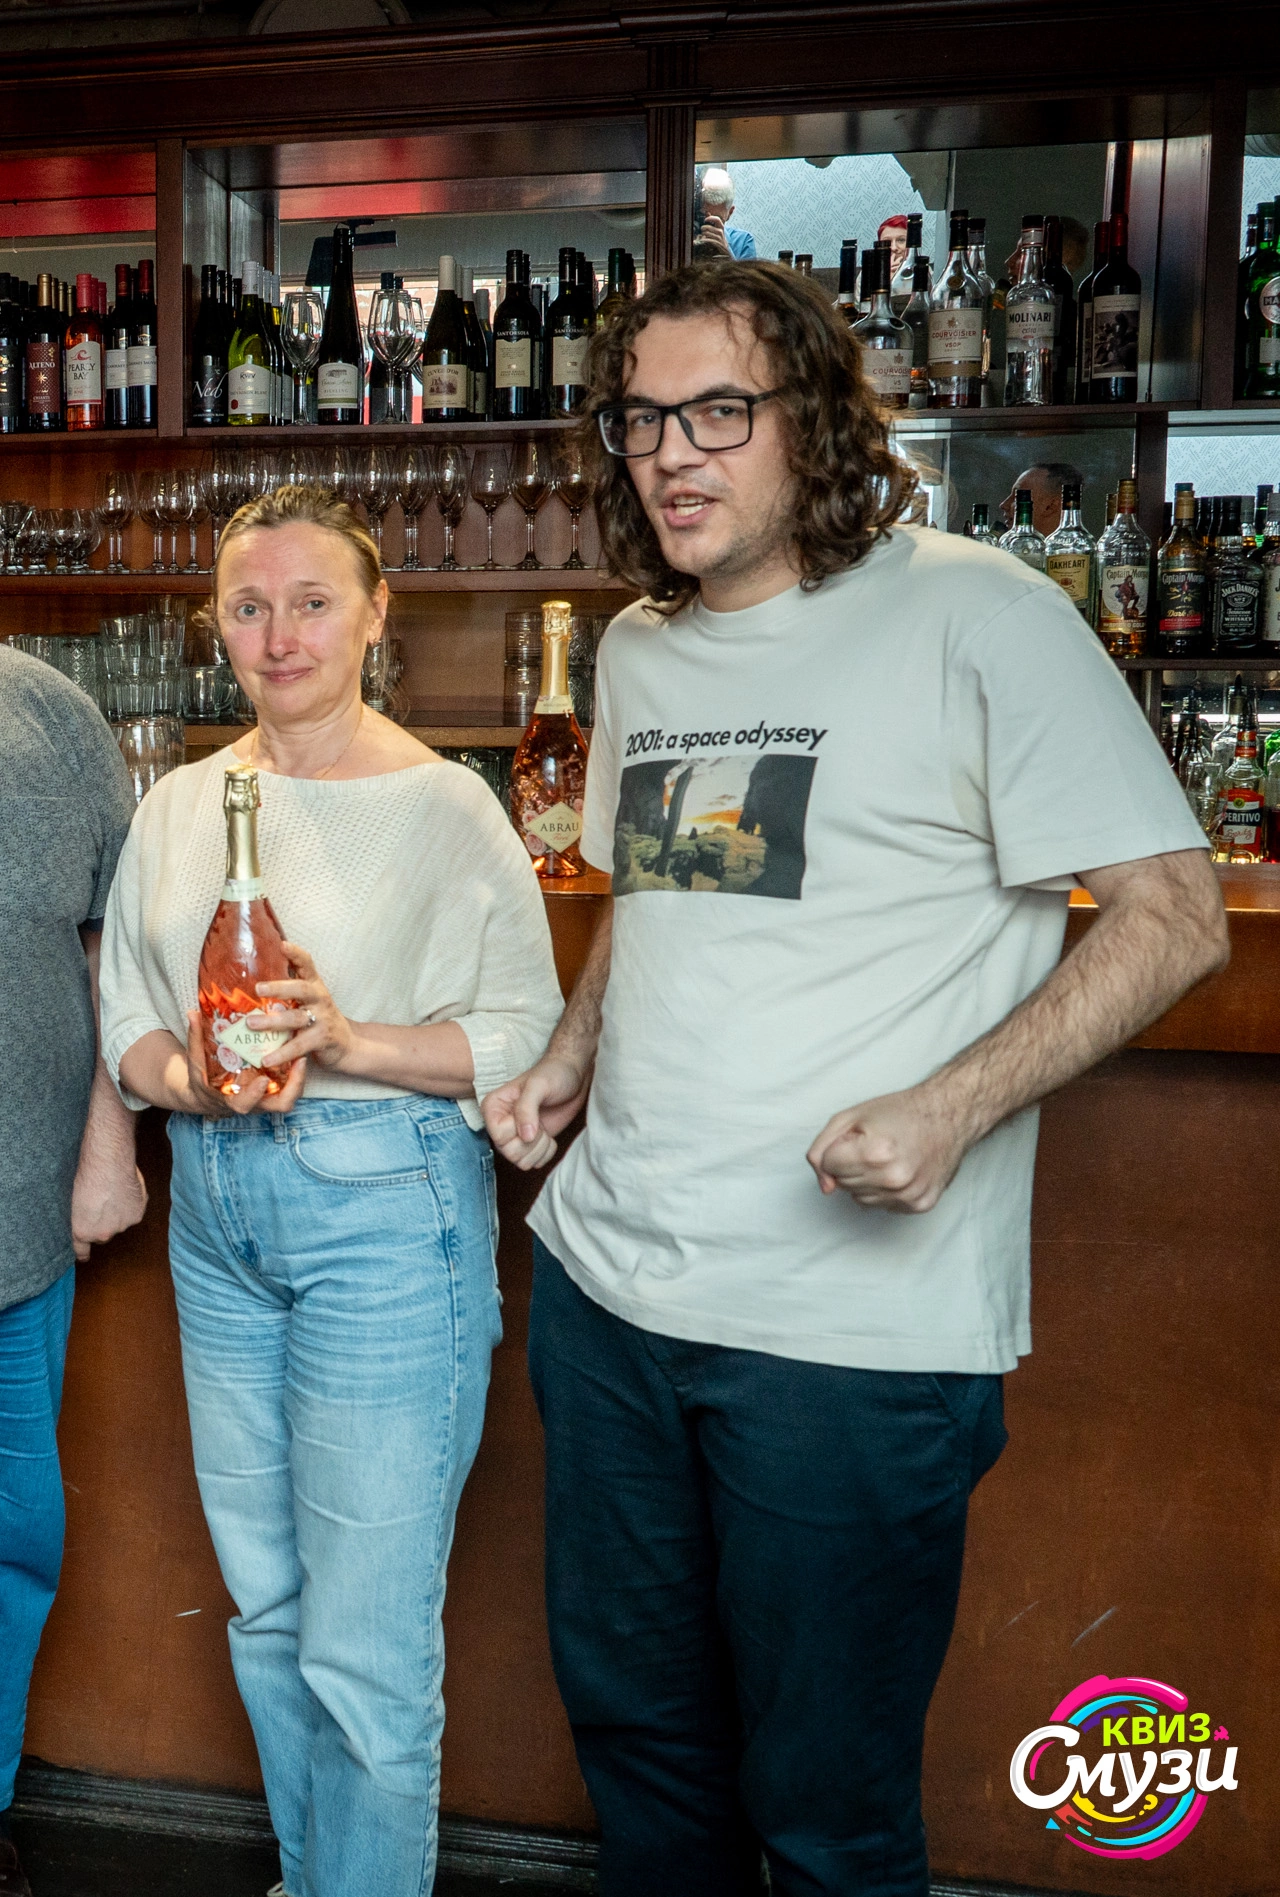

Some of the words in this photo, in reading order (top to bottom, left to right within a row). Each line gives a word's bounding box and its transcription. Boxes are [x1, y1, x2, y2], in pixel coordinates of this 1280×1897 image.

[1009, 312, 1051, 323] MOLINARI
[932, 330, 977, 339] COURVOISIER
[29, 361, 56, 369] ALTENO
[68, 363, 96, 372] PEARY
[872, 367, 911, 375] COURVOIS
[1049, 559, 1086, 570] OAKHEART
[1107, 568, 1130, 581] Captain
[1131, 568, 1148, 580] Morg
[1162, 573, 1186, 585] Captain
[625, 729, 664, 757] 2001:
[666, 734, 678, 749] a
[679, 729, 731, 753] space
[735, 720, 828, 750] odyssey
[1224, 812, 1261, 823] PERITIVO
[539, 822, 579, 832] ABRAU
[234, 1031, 280, 1045] ABRAU
